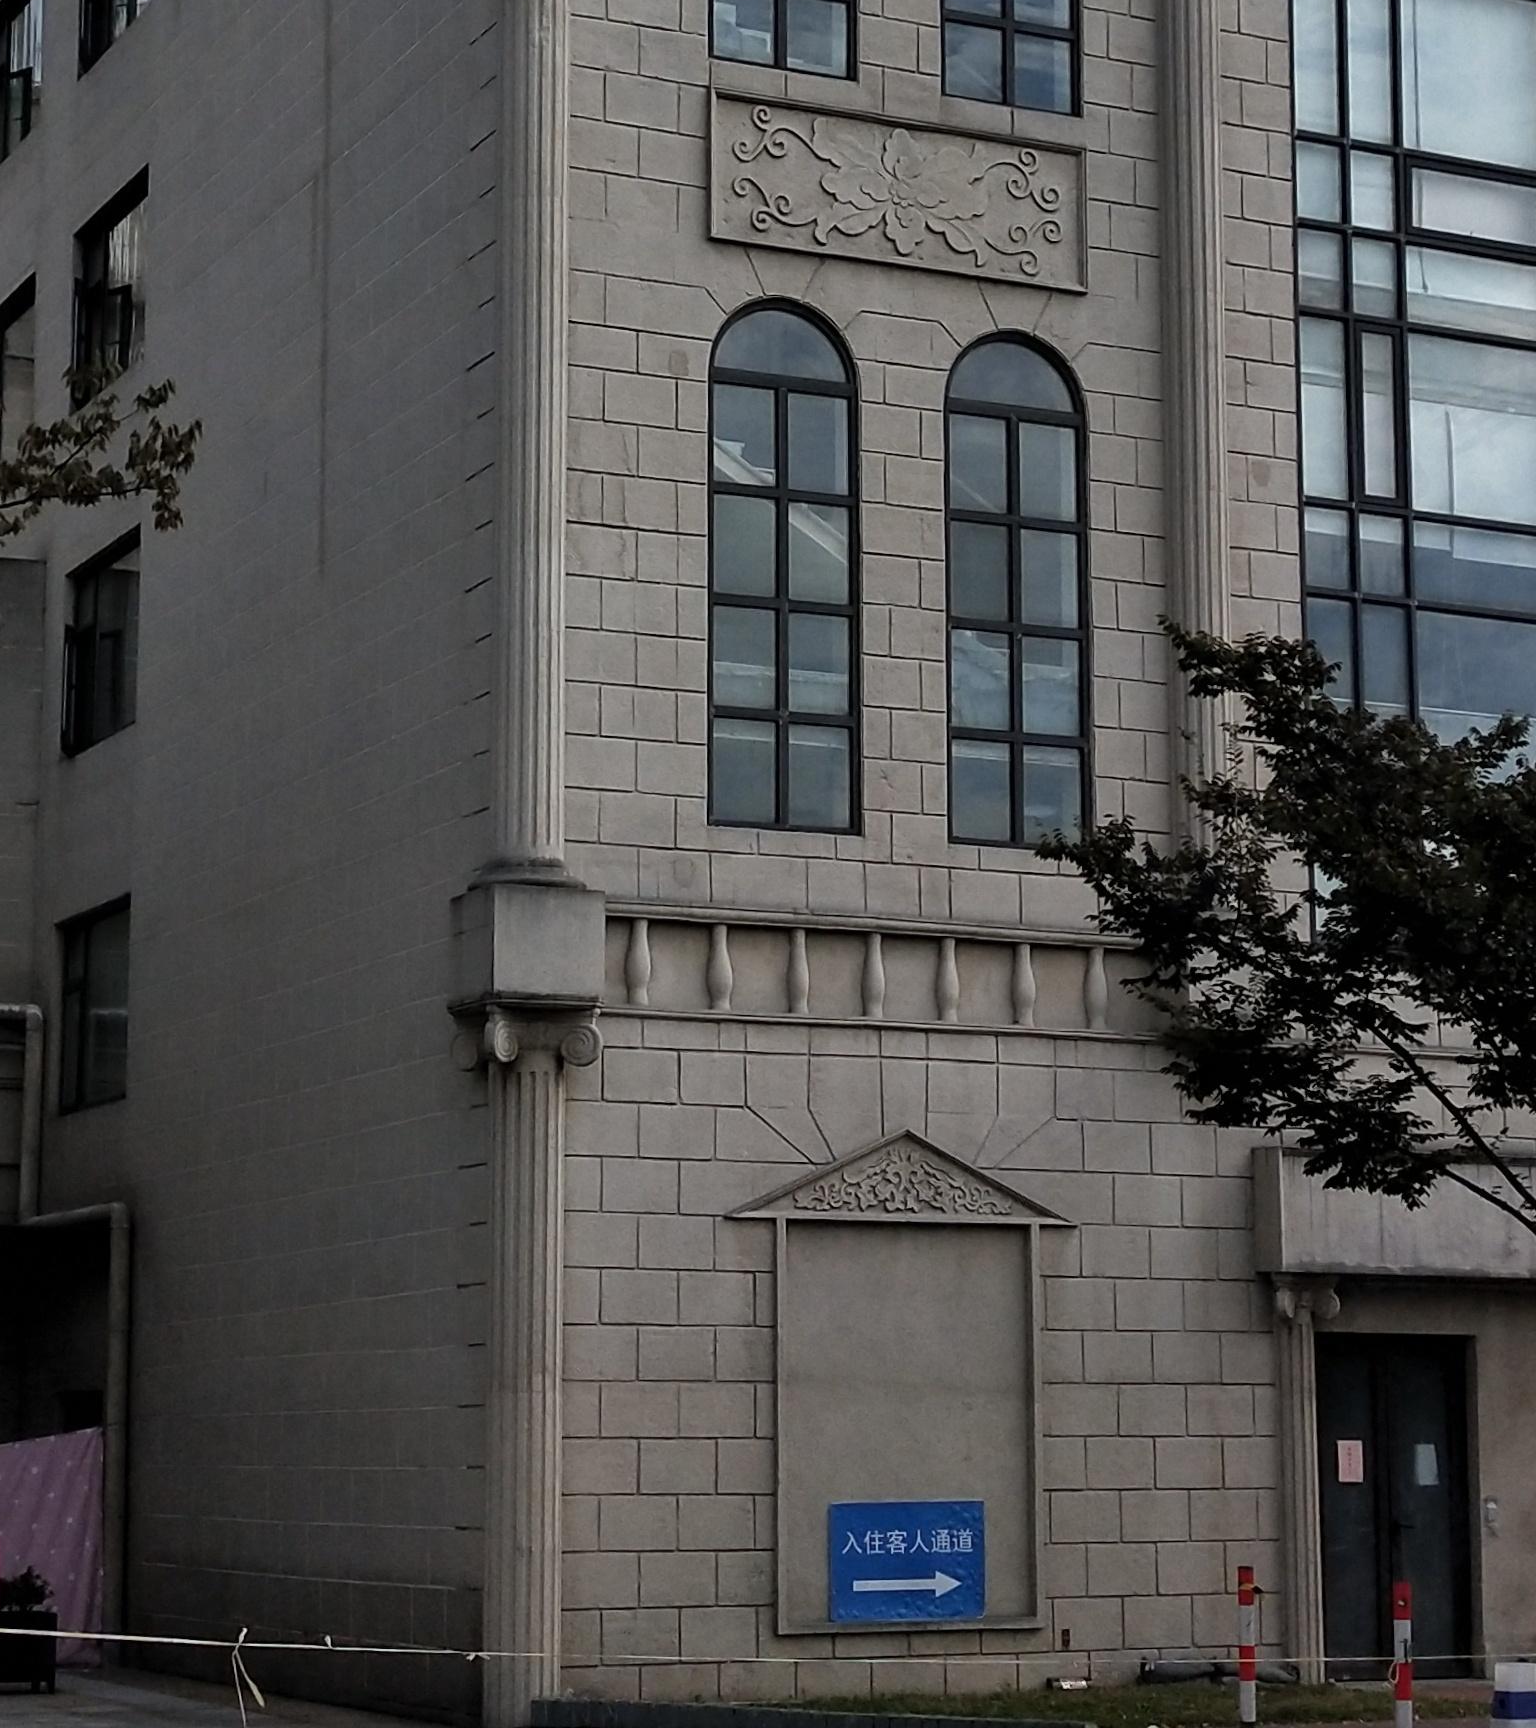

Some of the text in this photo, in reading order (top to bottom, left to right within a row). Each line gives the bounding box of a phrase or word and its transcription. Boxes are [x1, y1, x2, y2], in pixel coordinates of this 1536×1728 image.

[841, 1527, 974, 1556] 入住客人通道
